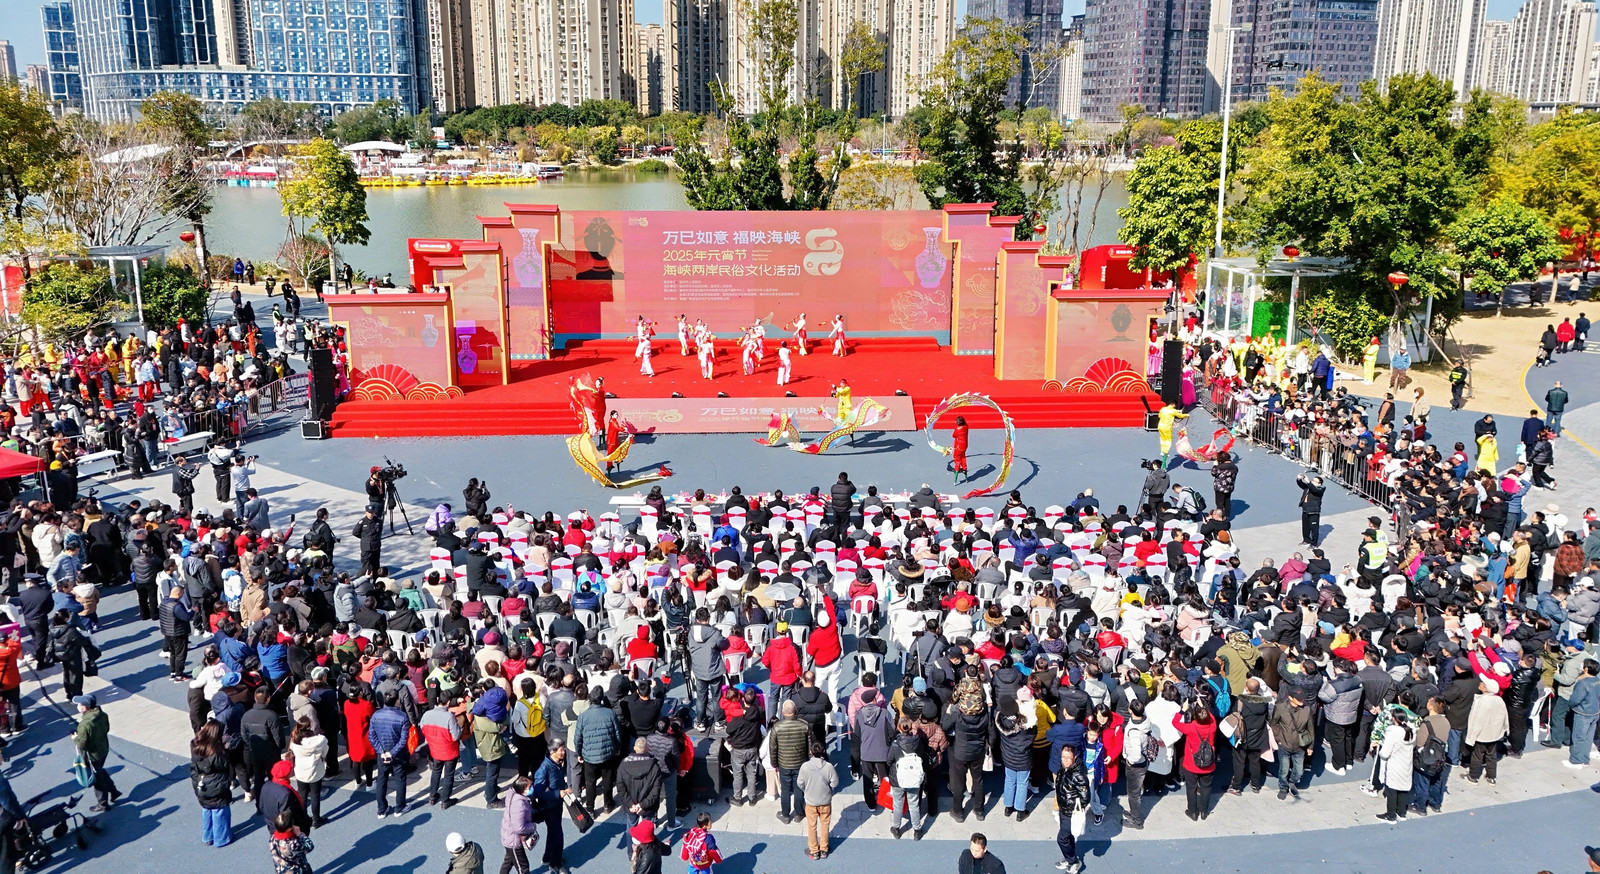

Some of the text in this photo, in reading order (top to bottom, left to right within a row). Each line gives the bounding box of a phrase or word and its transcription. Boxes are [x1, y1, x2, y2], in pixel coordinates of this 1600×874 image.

[663, 230, 801, 245] 万巳如意 福映海峡
[663, 249, 747, 262] 2025年元宵节
[663, 264, 801, 277] 海峡两岸民俗文化活动
